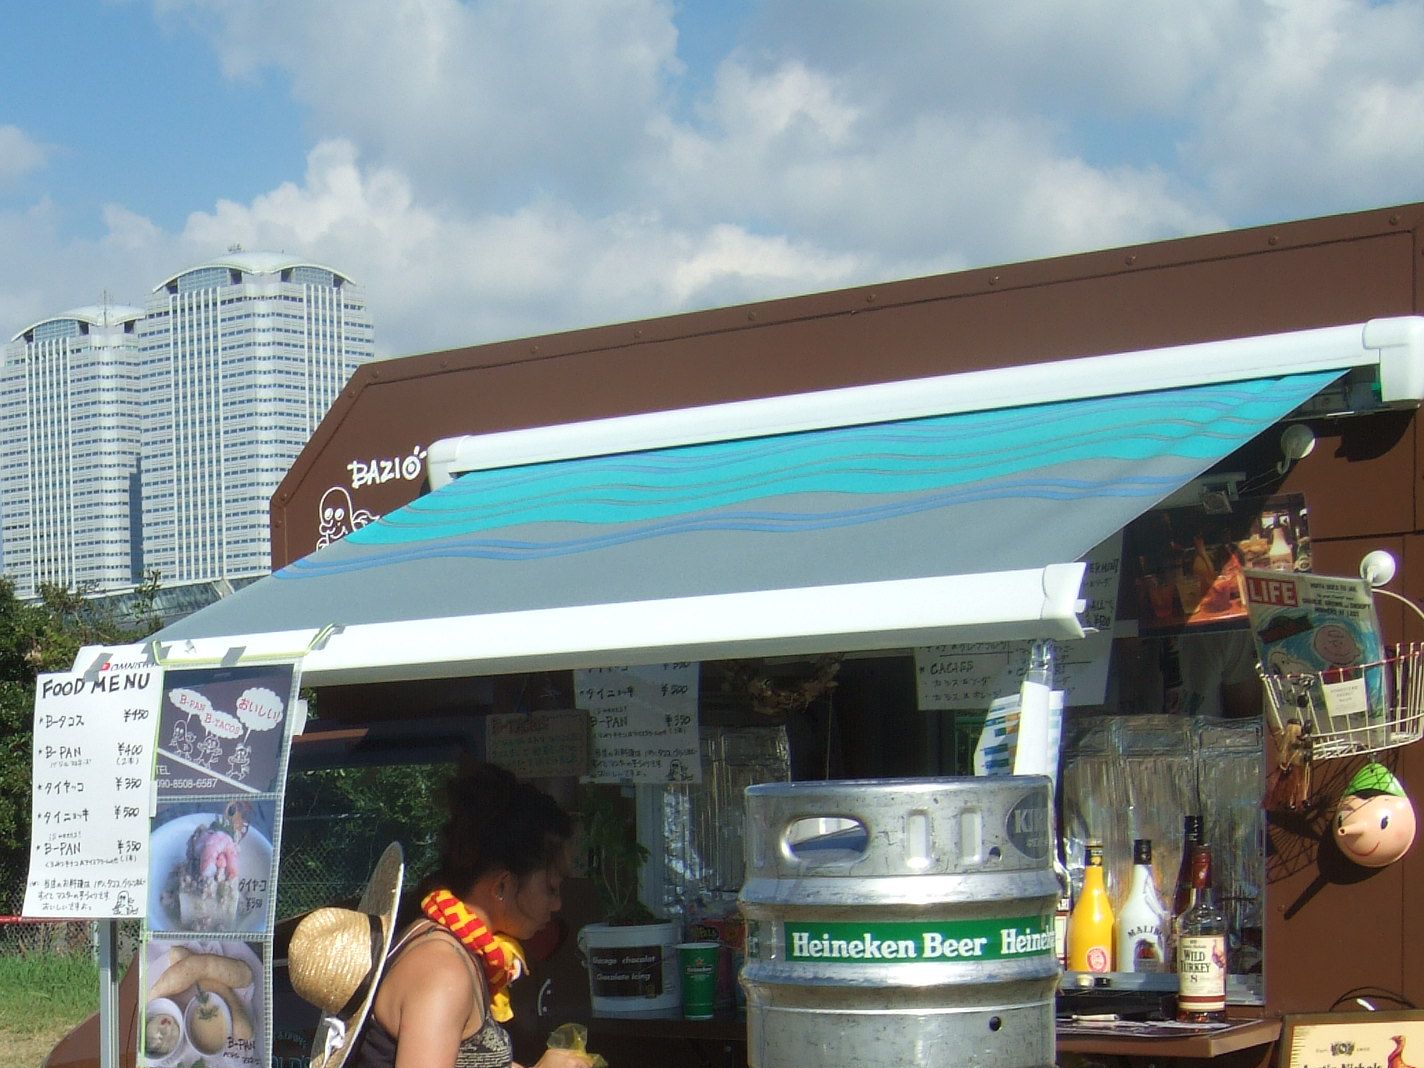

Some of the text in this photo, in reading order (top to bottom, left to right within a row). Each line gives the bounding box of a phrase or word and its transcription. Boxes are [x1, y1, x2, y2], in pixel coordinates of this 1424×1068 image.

[1248, 578, 1297, 607] LIFE
[43, 672, 151, 699] FOOD MENU
[792, 932, 917, 959] Heineken
[922, 932, 987, 958] Beer
